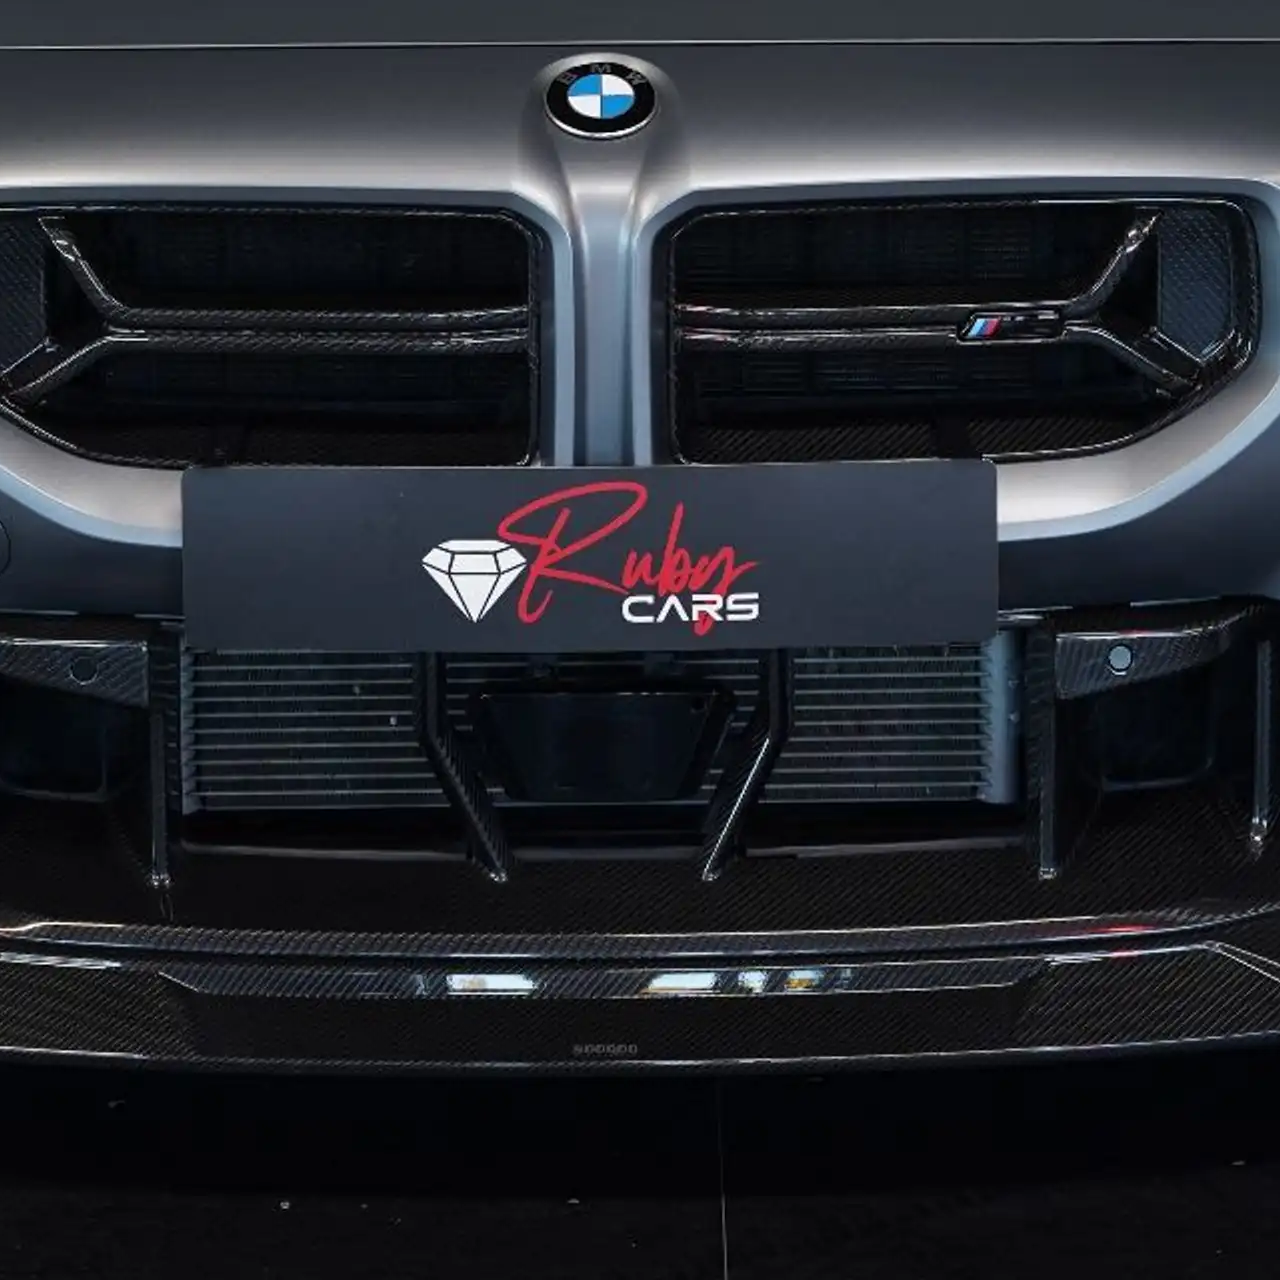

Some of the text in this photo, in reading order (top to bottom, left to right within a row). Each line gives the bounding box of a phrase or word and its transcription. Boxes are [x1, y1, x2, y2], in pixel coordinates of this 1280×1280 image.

[557, 64, 647, 86] BMW
[497, 481, 761, 636] Ruby
[622, 592, 760, 624] CARS
